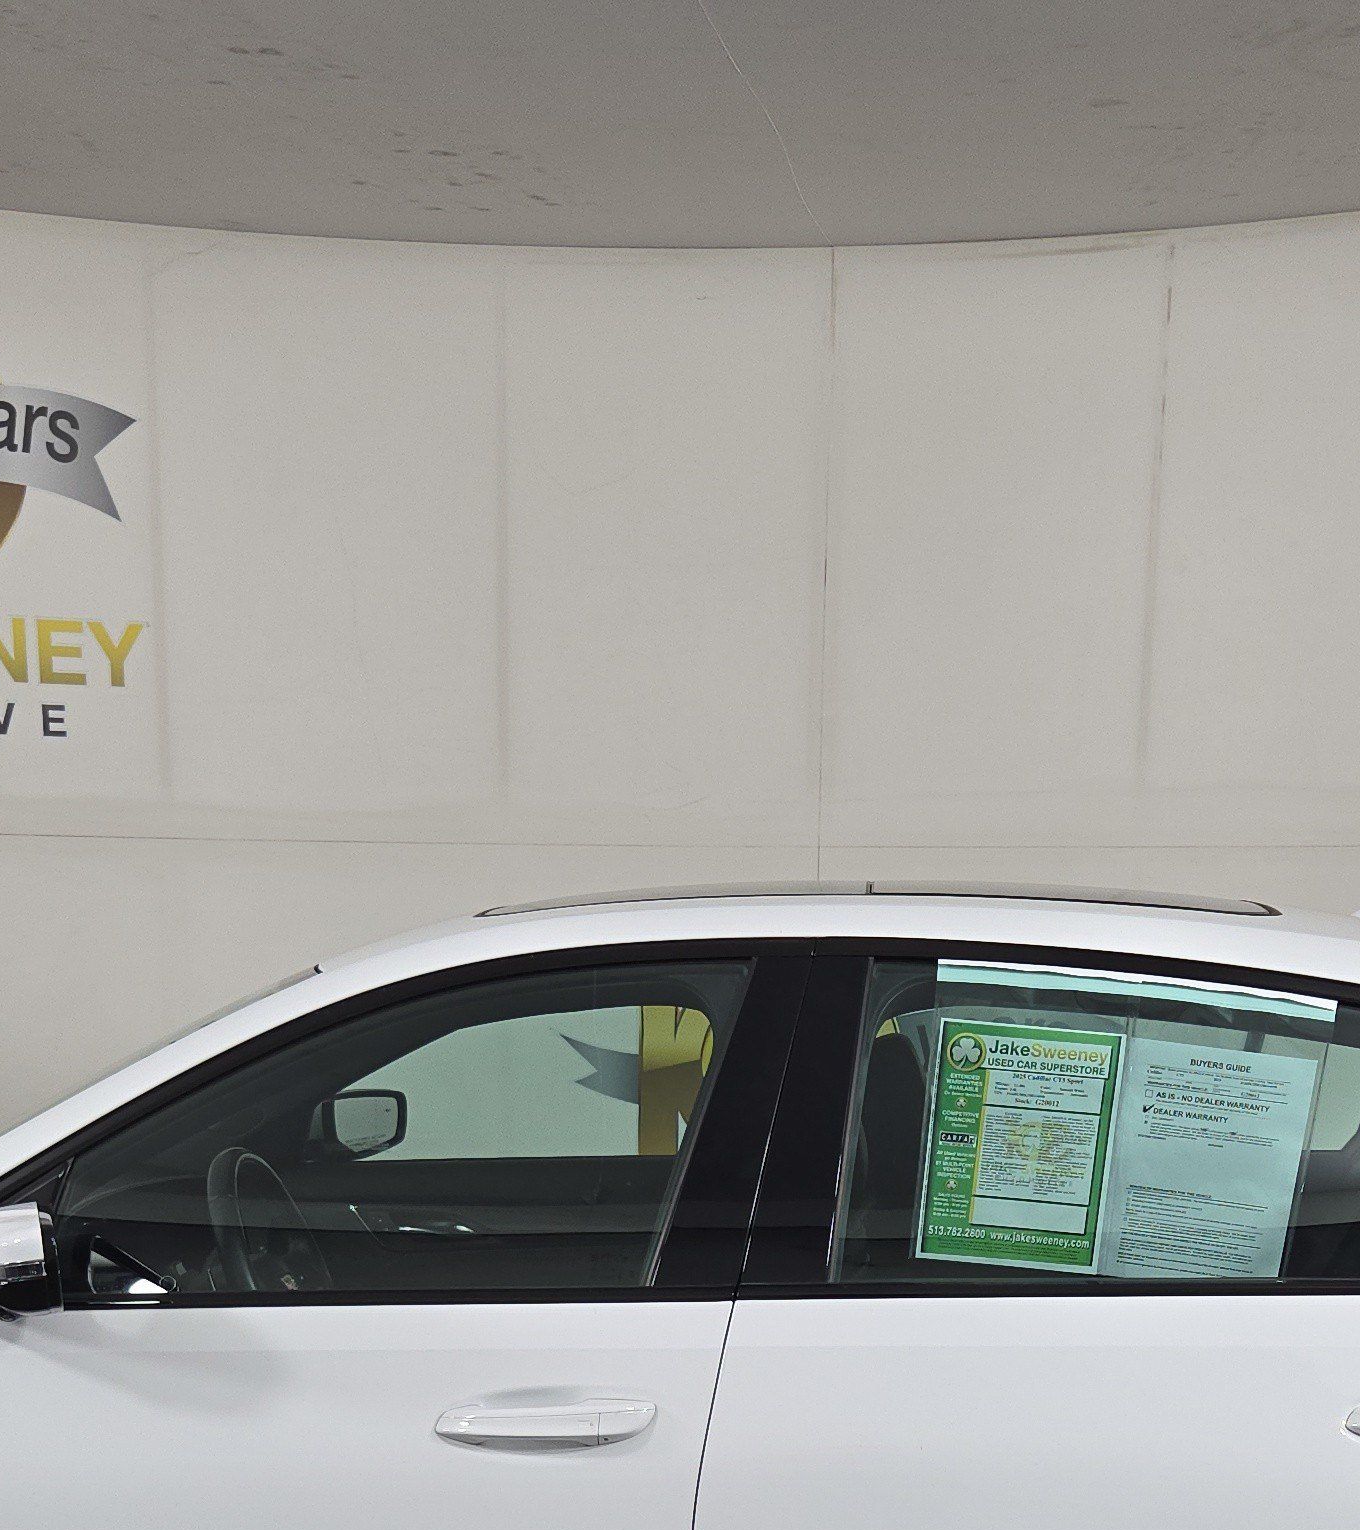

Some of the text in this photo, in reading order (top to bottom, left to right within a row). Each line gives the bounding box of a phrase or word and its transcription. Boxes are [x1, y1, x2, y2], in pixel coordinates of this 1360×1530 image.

[987, 1057, 1106, 1076] USED CAR SUPERSTORE
[1189, 1058, 1252, 1073] BUYERS GUIDE
[1156, 1091, 1167, 1099] AS
[1181, 1094, 1192, 1102] NO
[1194, 1096, 1226, 1107] DEALER
[1226, 1100, 1271, 1113] WARRANTY
[1153, 1107, 1229, 1124] DEALER WARRANTY
[990, 1231, 1090, 1249] www.jakesweeney.com
